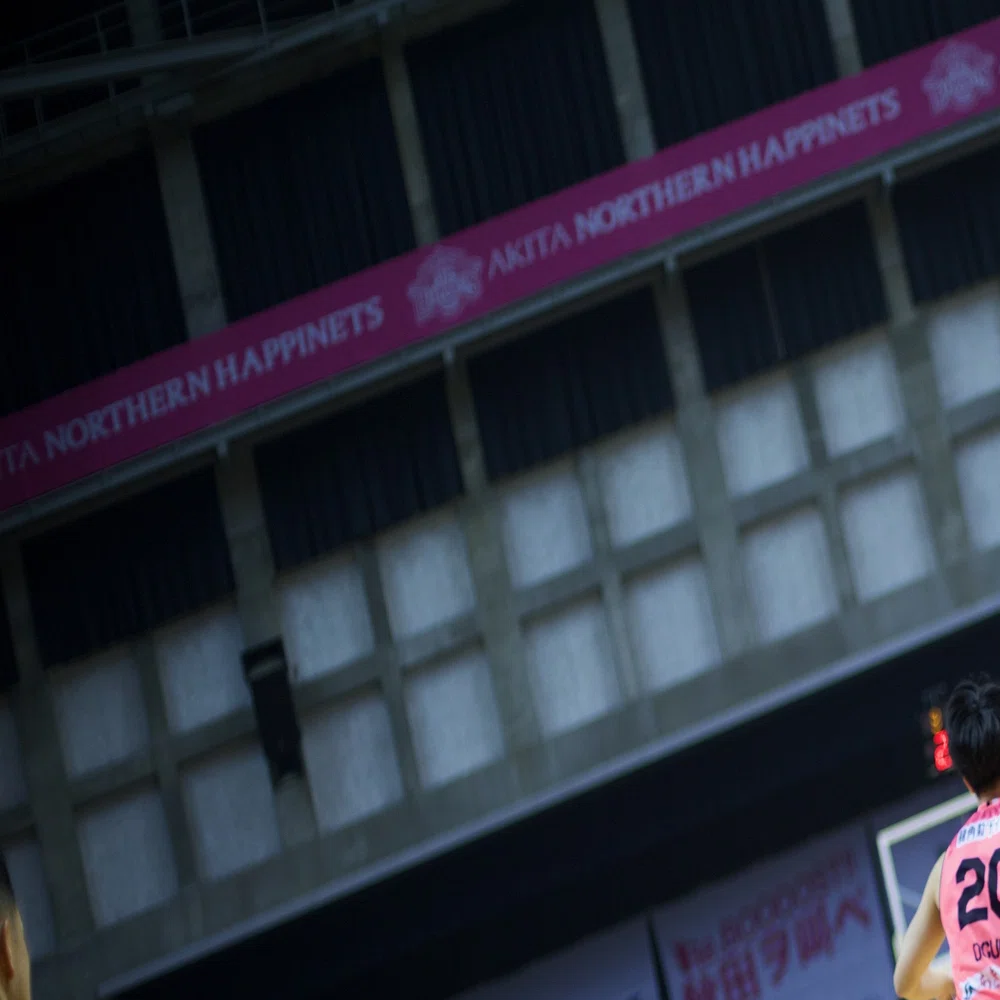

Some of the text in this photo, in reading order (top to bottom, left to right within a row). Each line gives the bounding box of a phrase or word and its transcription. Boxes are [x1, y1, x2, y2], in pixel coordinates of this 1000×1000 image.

[487, 90, 901, 279] AKITA NORTHERN HAPPINETS
[43, 364, 211, 459] NORTHERN
[213, 295, 385, 389] HAPPINETS
